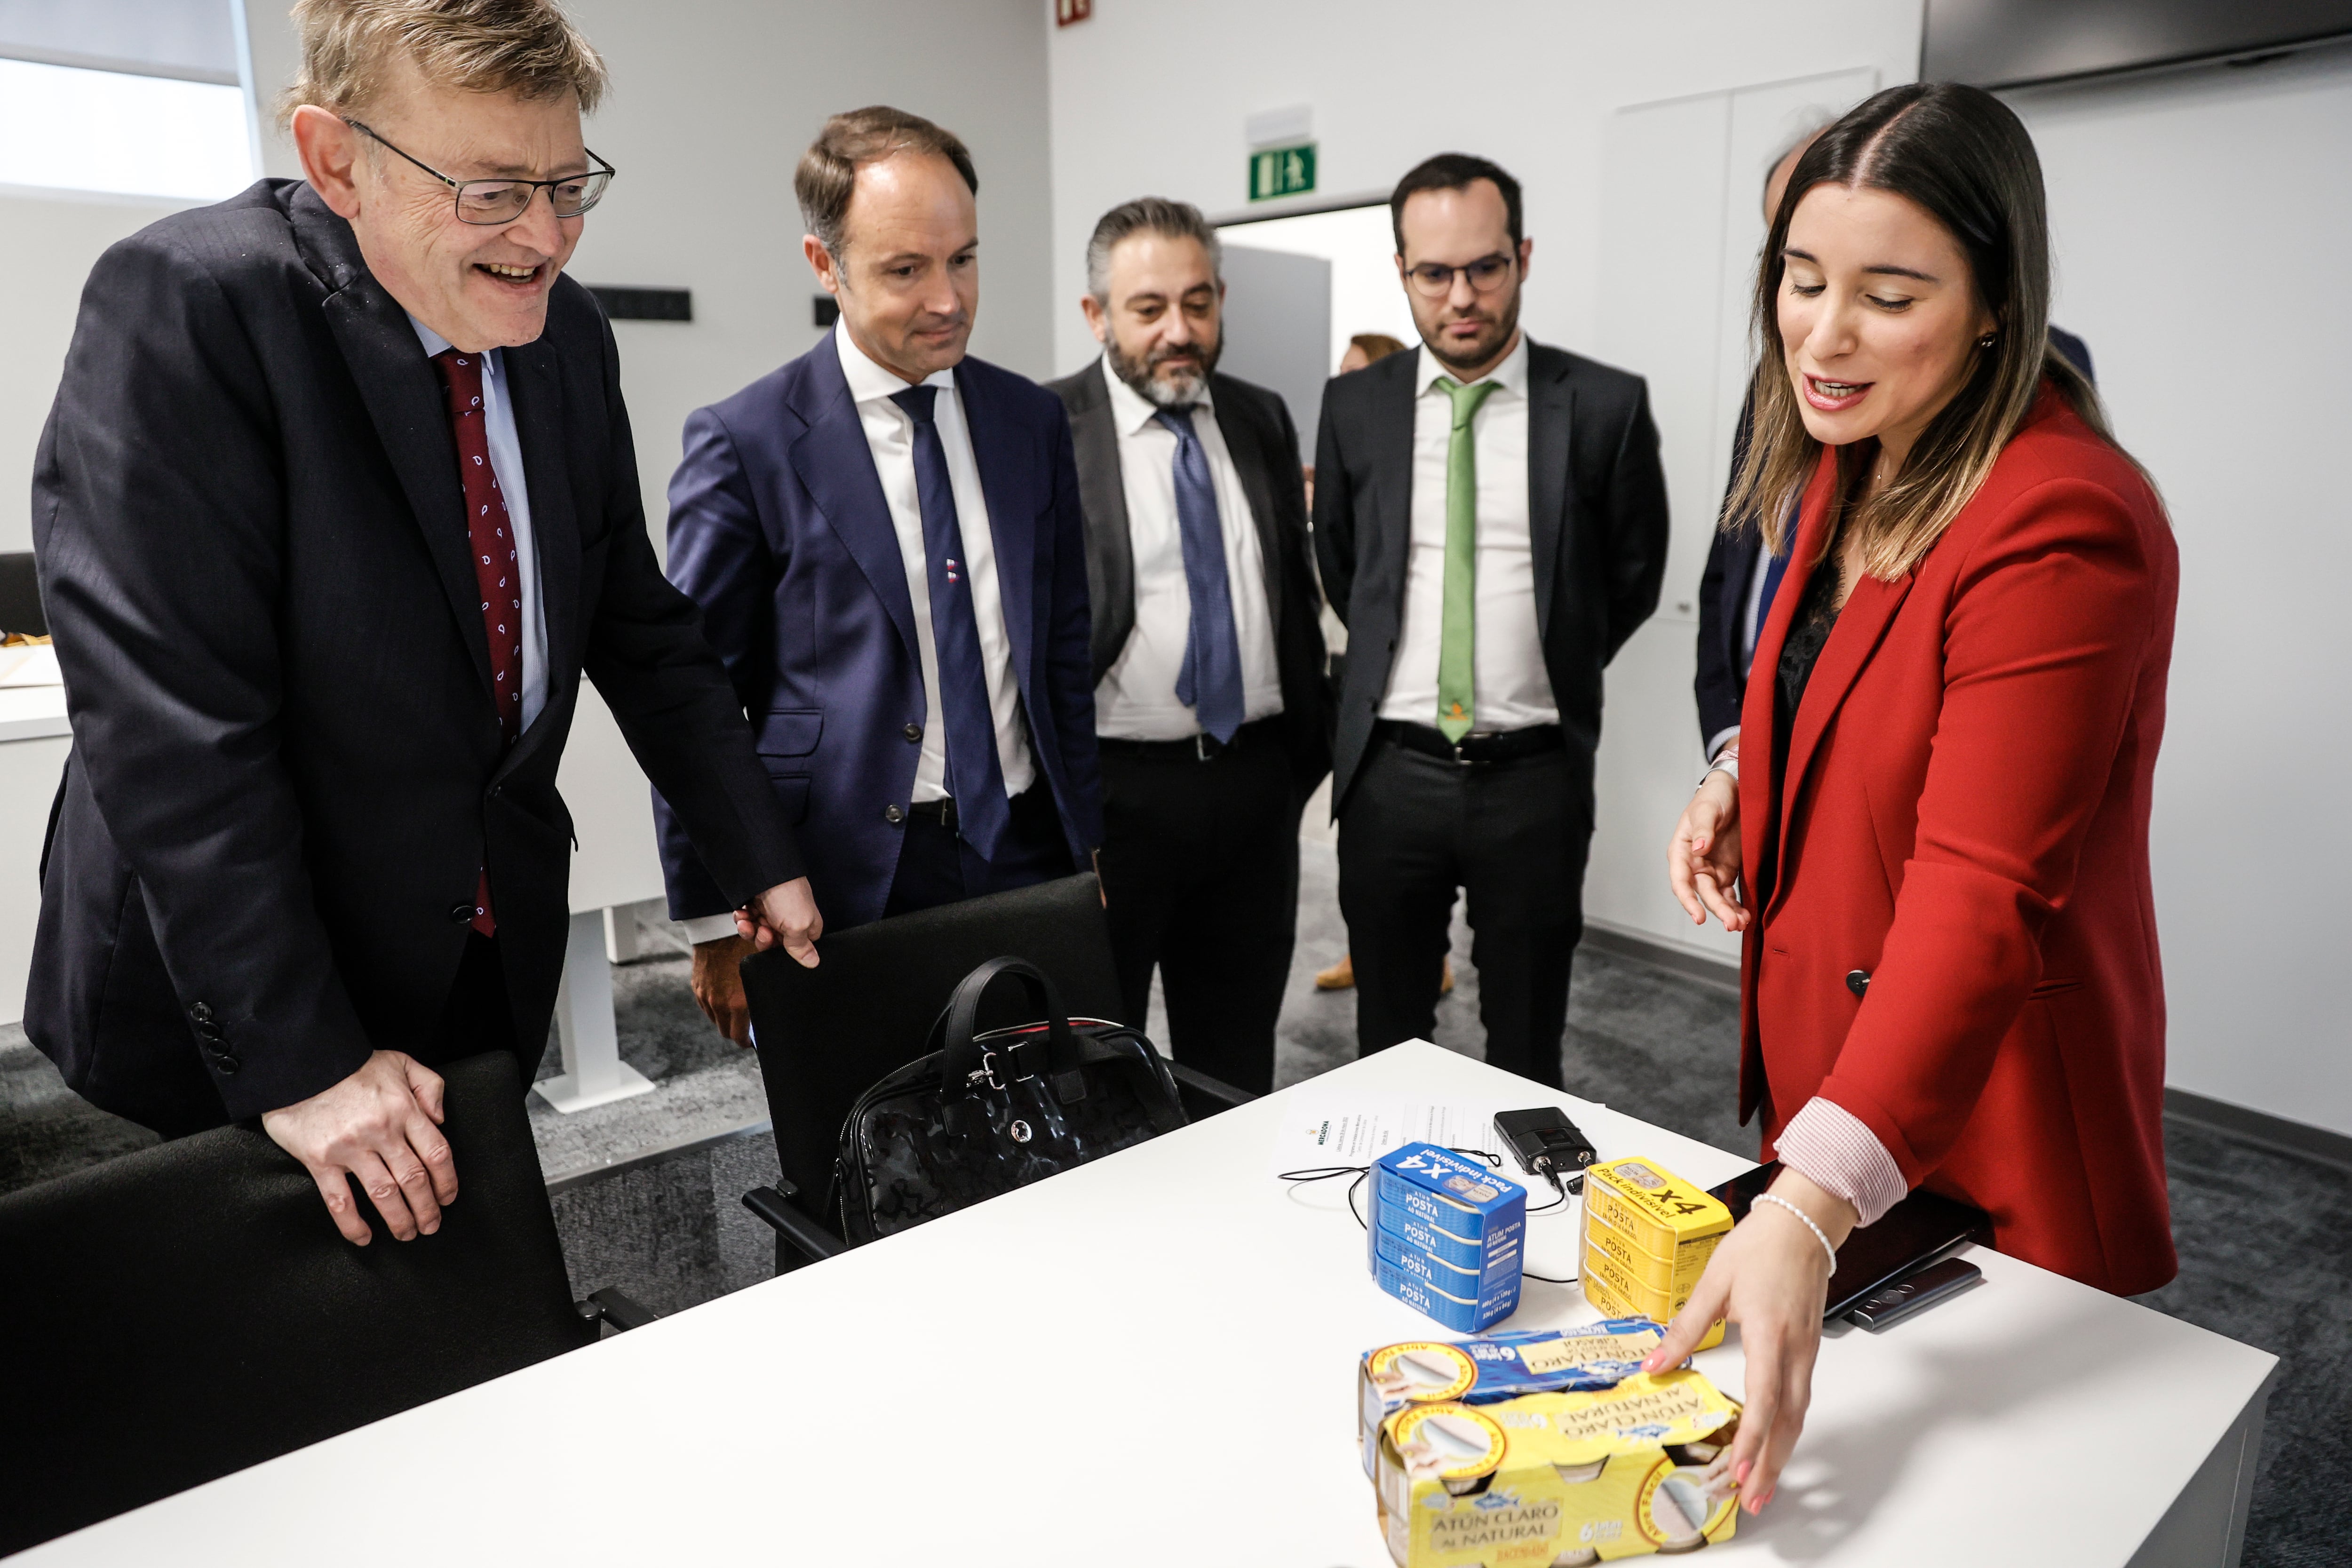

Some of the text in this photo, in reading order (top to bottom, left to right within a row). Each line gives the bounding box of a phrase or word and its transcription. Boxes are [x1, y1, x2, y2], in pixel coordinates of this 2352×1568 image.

[1318, 1121, 1329, 1145] MERCADONA
[1481, 1175, 1513, 1193] Pack
[1597, 1167, 1623, 1185] Pack
[1406, 1193, 1438, 1218] POSTA
[1414, 1191, 1430, 1202] ATUM
[1413, 1221, 1429, 1232] ATUM
[1415, 1208, 1435, 1224] NATURAL
[1608, 1205, 1633, 1231] POSTA
[1405, 1223, 1437, 1247] POSTA
[1487, 1229, 1504, 1242] ATUM
[1505, 1222, 1521, 1234] POSTA
[1414, 1238, 1433, 1253] NATURAL
[1606, 1237, 1631, 1264] POSTA
[1401, 1255, 1432, 1280] POSTA
[1409, 1253, 1425, 1264] ATUM
[1408, 1282, 1423, 1293] ATUM
[1605, 1264, 1629, 1291] POSTA
[1399, 1283, 1430, 1309] POSTA
[1409, 1298, 1428, 1314] NATURAL
[1499, 1346, 1516, 1361] 6
[1532, 1349, 1603, 1369] CLARO
[1570, 1393, 1661, 1422] NATURAL
[1646, 1397, 1699, 1424] ATÚN
[1564, 1415, 1637, 1438] CLARO
[1432, 1505, 1559, 1532] ATÚN CLARO
[1463, 1523, 1544, 1546] NATURAL
[1579, 1521, 1593, 1544] 6
